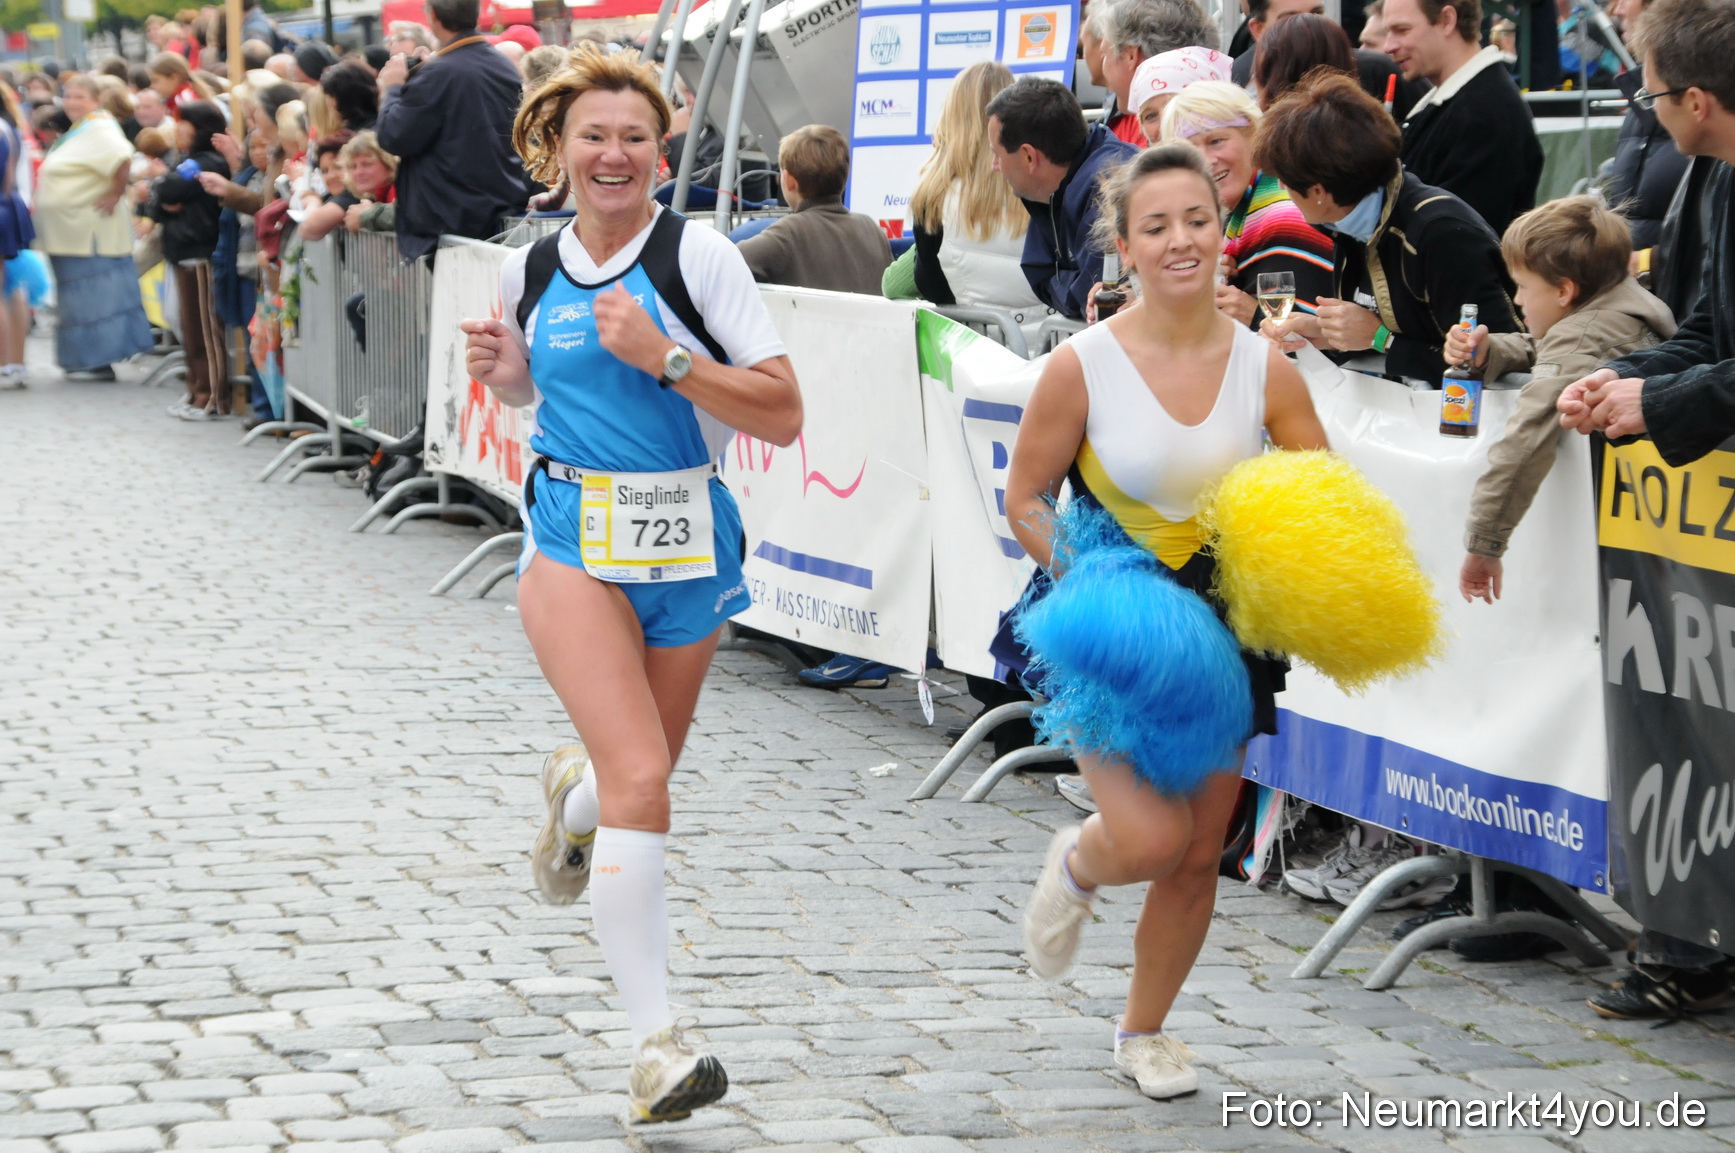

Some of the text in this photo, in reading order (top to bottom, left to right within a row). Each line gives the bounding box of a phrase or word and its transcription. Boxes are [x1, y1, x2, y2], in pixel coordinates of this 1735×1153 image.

[860, 99, 893, 115] MCM
[1444, 393, 1466, 405] Spezi
[617, 484, 690, 509] Sieglinde
[586, 516, 595, 531] C
[630, 517, 691, 547] 723
[775, 586, 881, 637] KASSENSYSTEME
[1385, 767, 1584, 852] www.bockonline.de
[594, 864, 621, 875] cep
